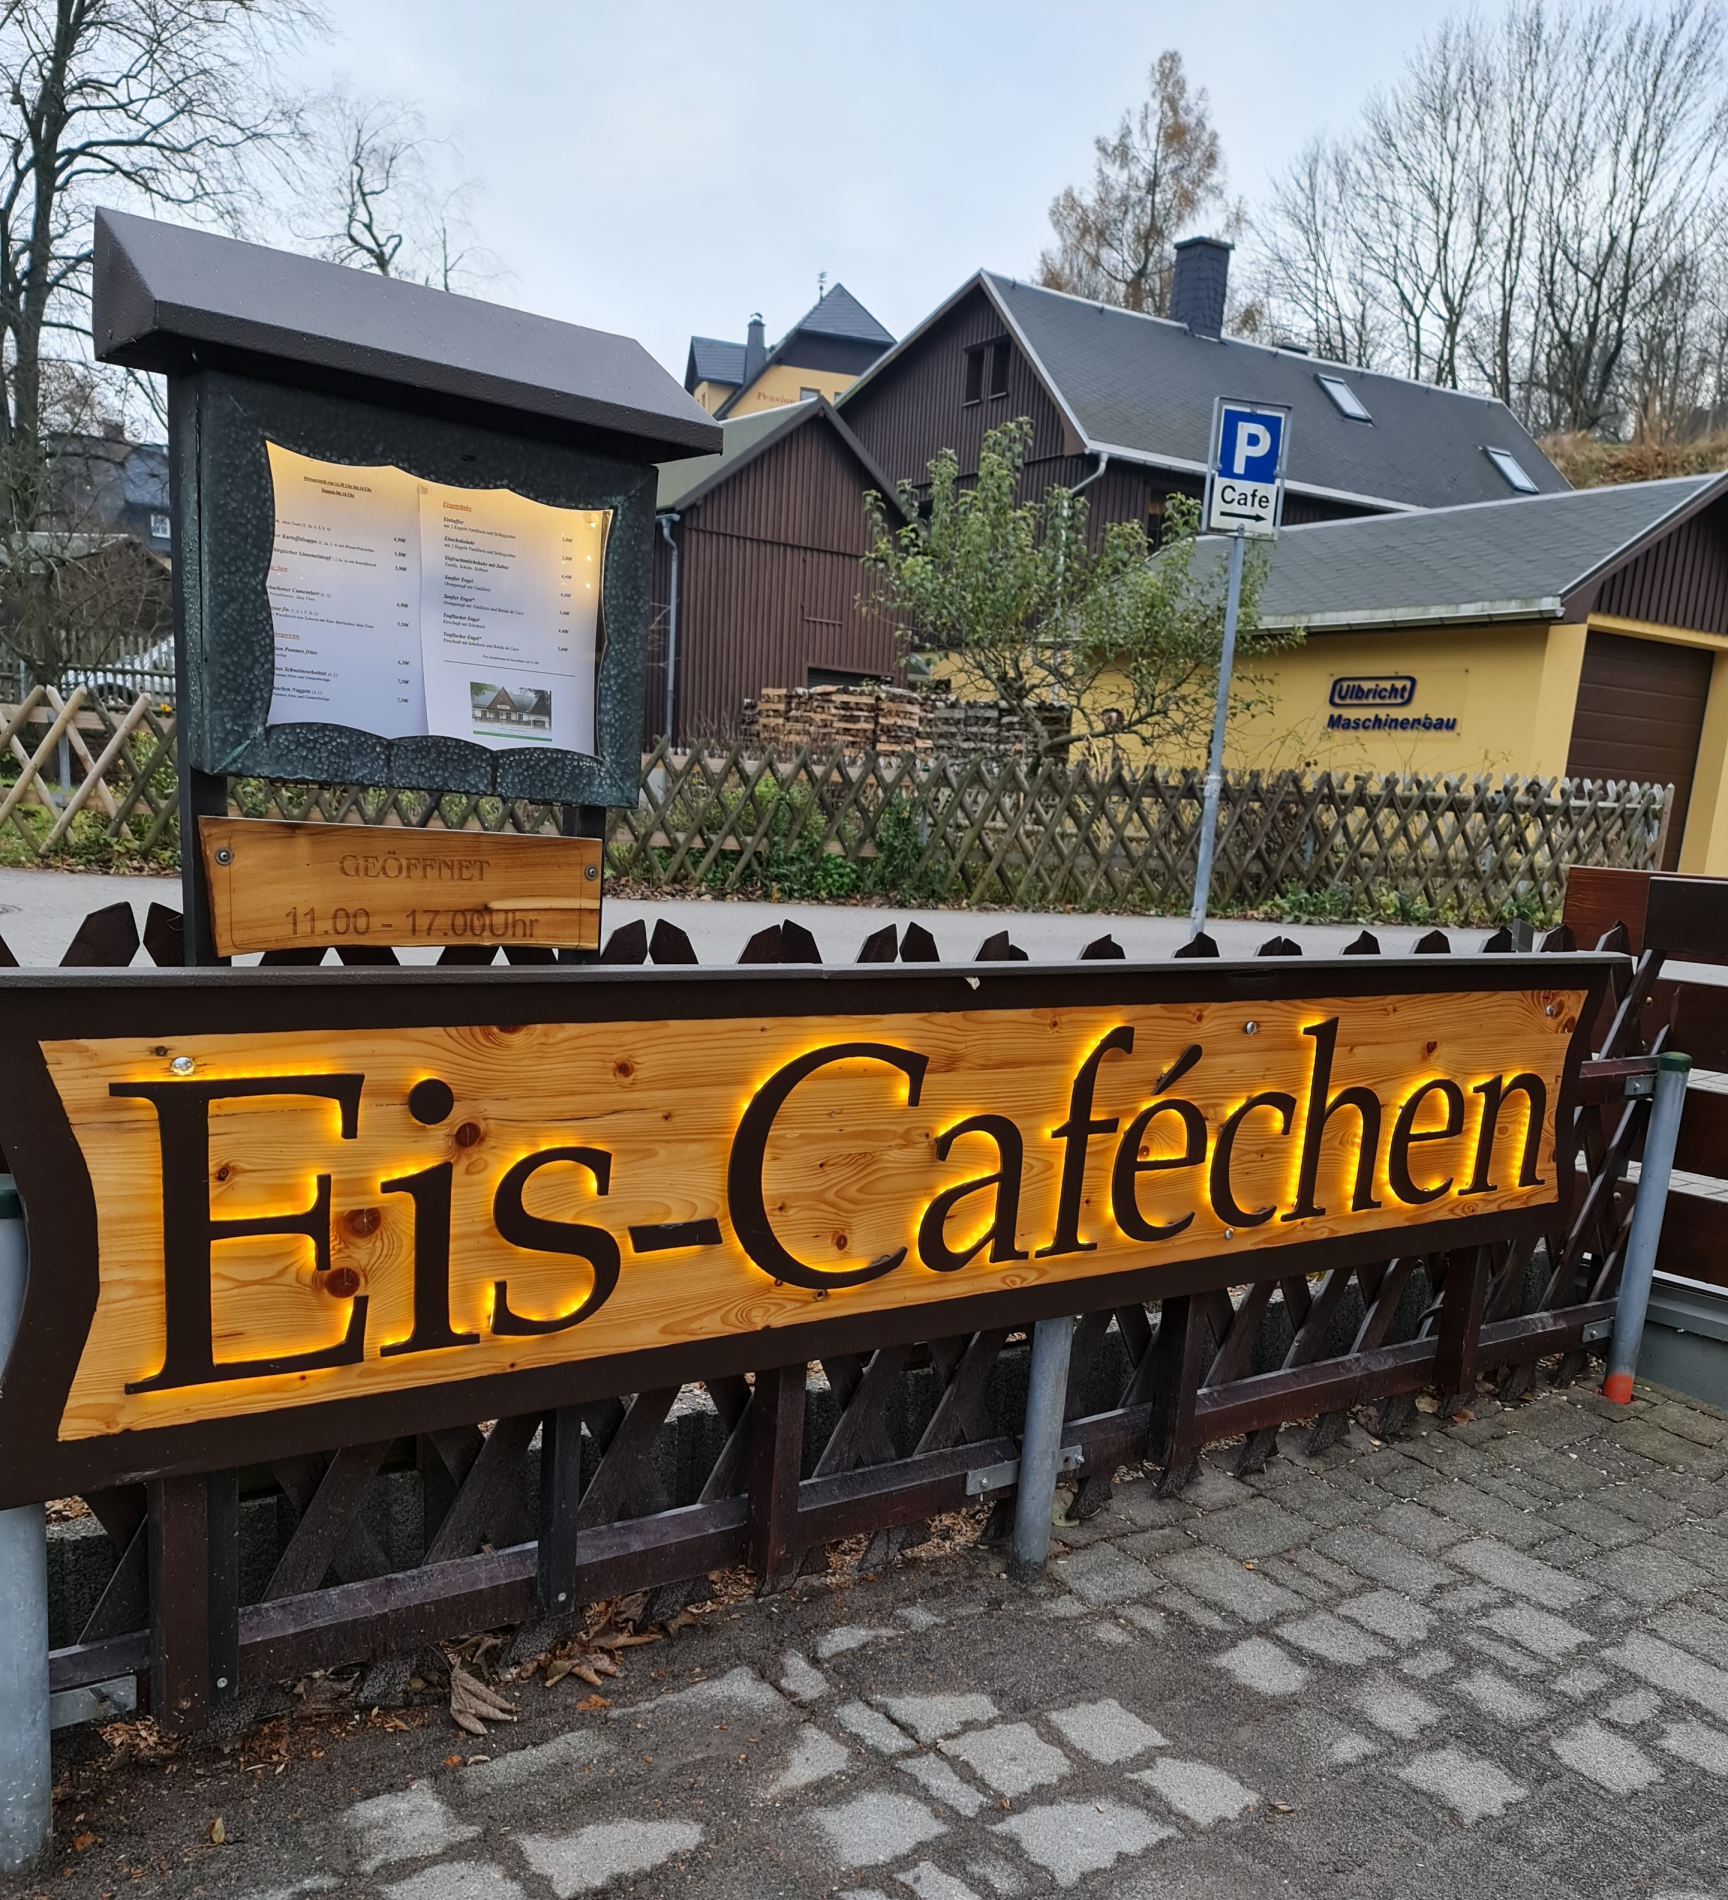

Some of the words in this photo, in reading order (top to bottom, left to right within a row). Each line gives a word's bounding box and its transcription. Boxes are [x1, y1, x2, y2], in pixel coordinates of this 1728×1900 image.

[757, 391, 796, 404] Pension
[1233, 421, 1272, 475] P
[1220, 485, 1270, 509] Cafe
[1336, 682, 1408, 701] Ulbricht
[1327, 714, 1457, 731] Maschinenbau
[338, 850, 491, 882] GEÖFFNET
[284, 906, 371, 936] 11.00
[109, 1016, 1547, 1395] Eis-Caféchen
